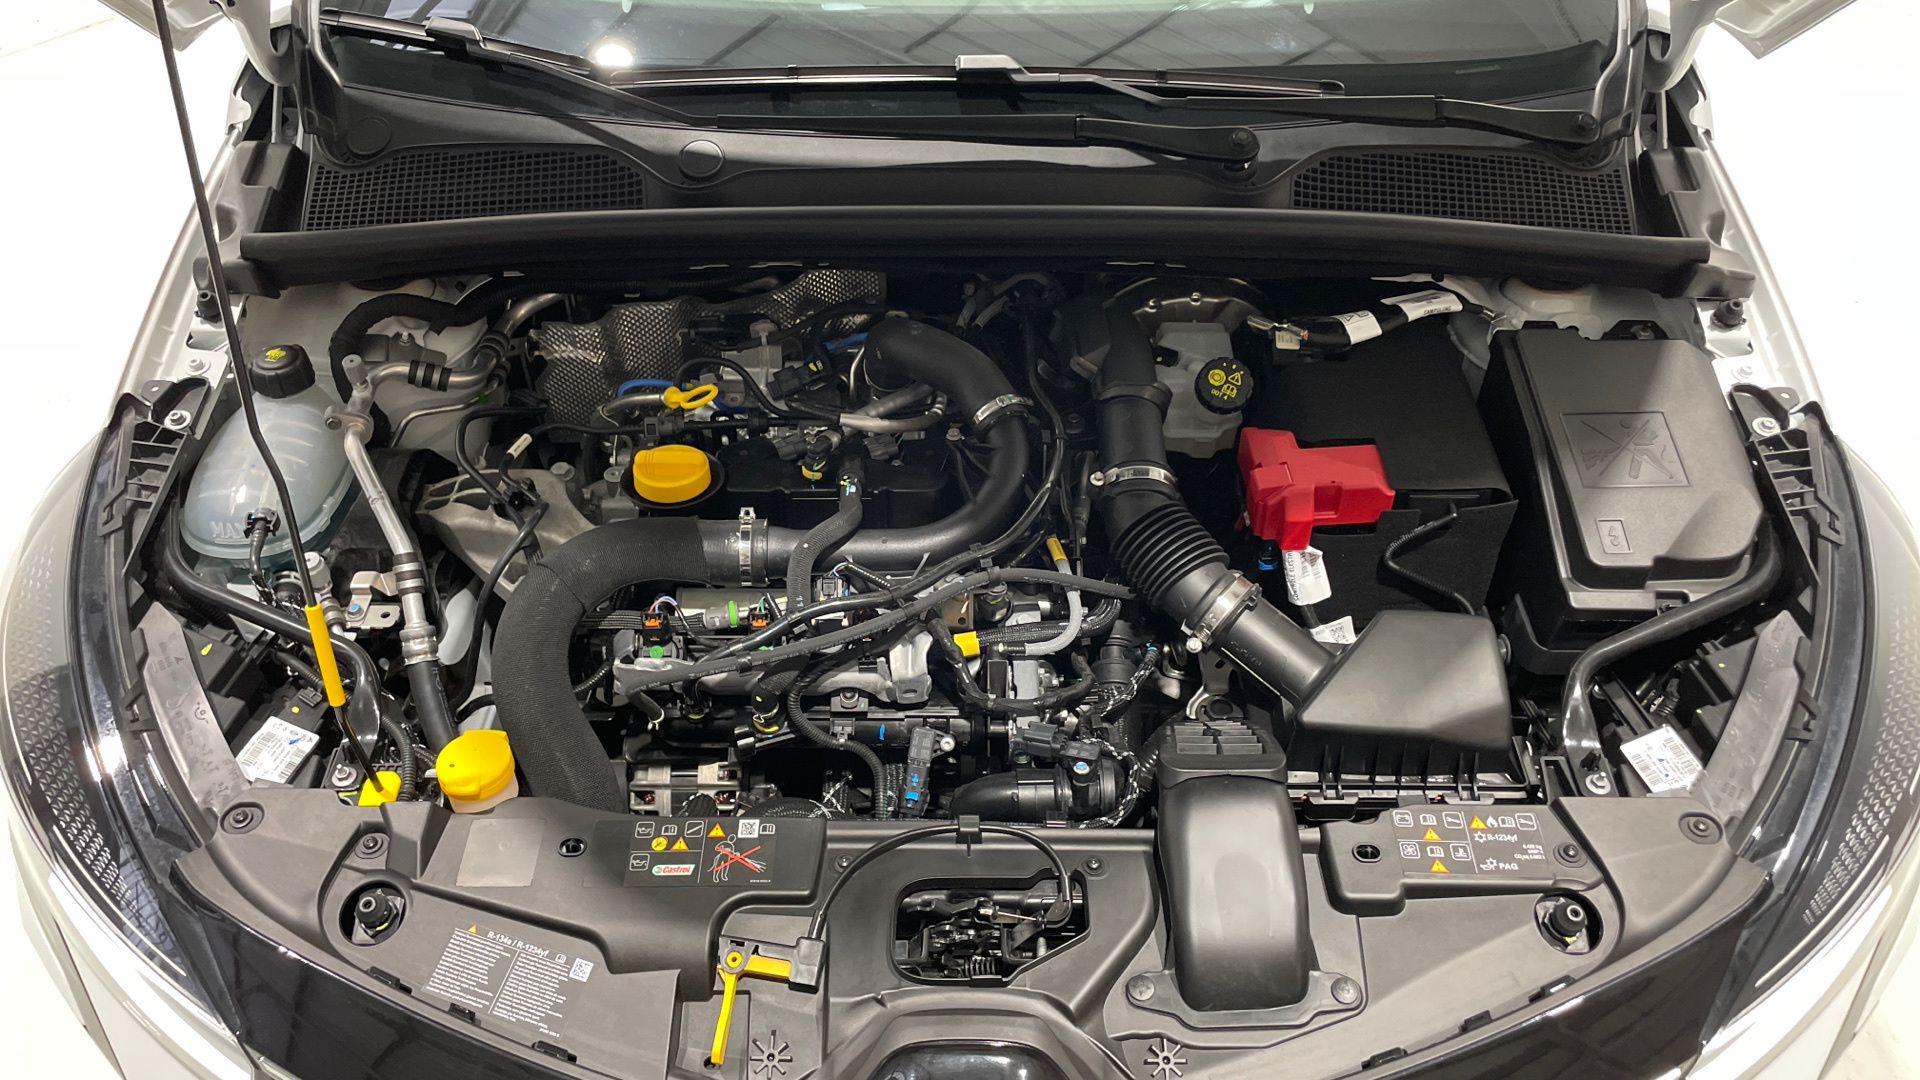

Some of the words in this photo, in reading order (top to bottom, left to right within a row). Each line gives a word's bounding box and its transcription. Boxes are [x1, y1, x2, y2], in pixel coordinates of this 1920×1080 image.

[1211, 388, 1223, 398] DOT
[1487, 833, 1518, 843] R-1234yf
[662, 865, 691, 874] Castrol
[1499, 862, 1519, 870] PAG
[487, 930, 512, 946] R-134a
[516, 940, 550, 958] R-1234yf
